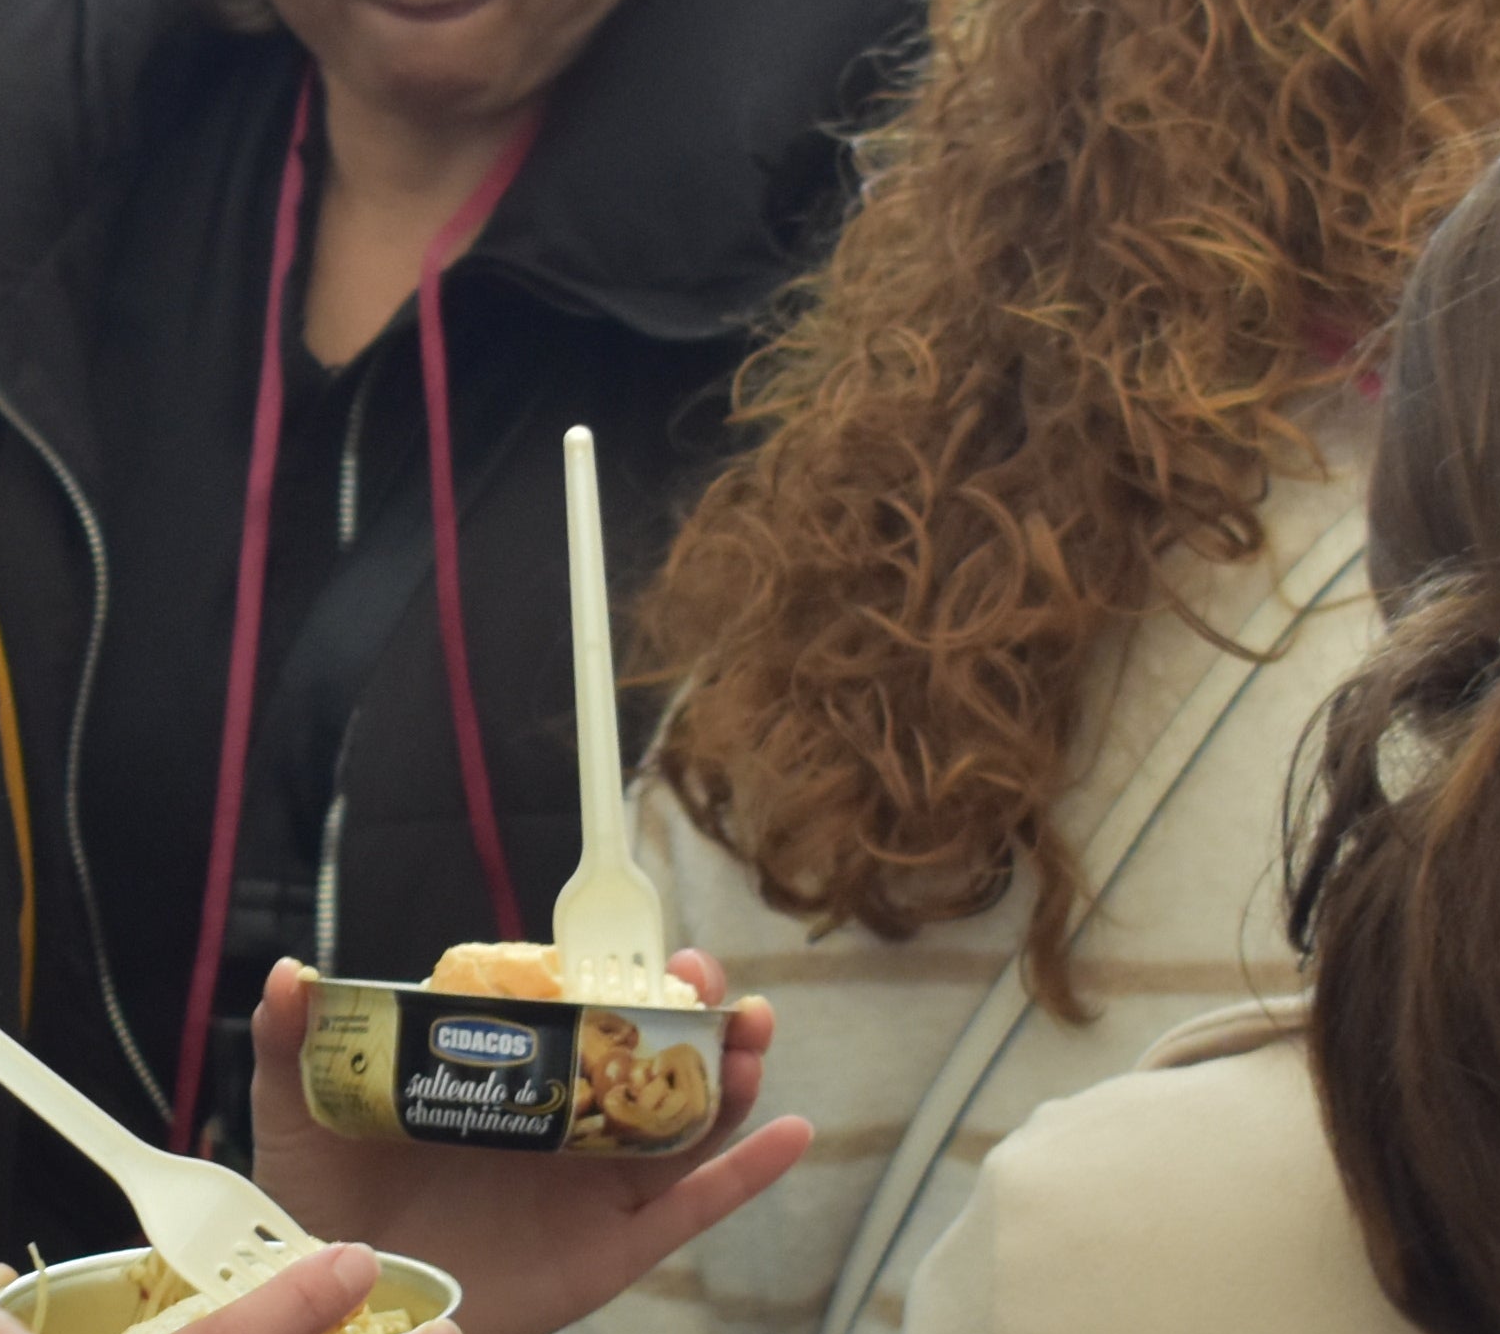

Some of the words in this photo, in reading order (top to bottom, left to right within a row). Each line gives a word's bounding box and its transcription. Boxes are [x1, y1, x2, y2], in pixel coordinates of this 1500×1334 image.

[438, 1027, 527, 1056] CIDACOS
[405, 1063, 508, 1103] salteado
[514, 1078, 538, 1105] de
[405, 1098, 553, 1137] champiñones
